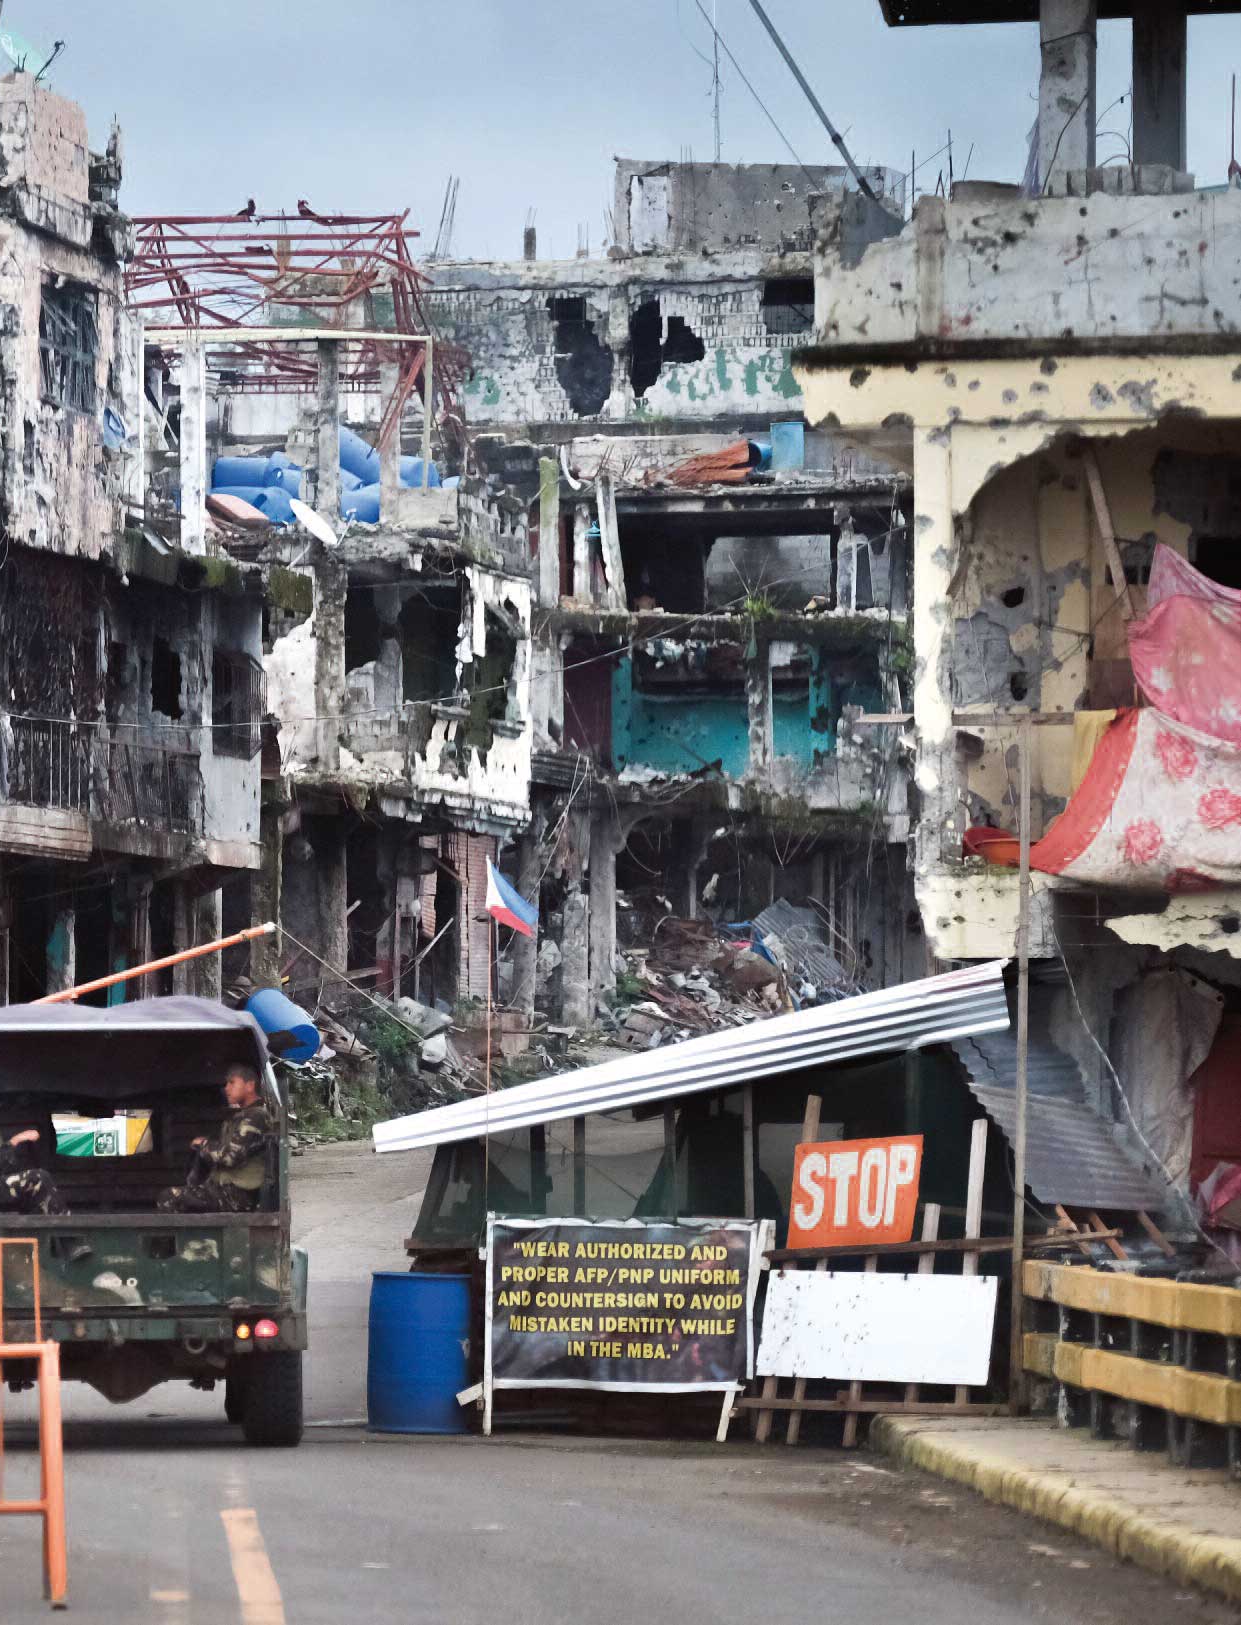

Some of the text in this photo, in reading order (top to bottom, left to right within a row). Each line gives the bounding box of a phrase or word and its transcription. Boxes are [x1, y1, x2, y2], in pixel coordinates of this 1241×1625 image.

[794, 1145, 917, 1230] STOP
[514, 1241, 728, 1261] "WEAR AUTHORIZED AND
[501, 1266, 740, 1287] PROPER AFP/PNP UNIFORM
[498, 1291, 743, 1310] AND COUNTERSIGN TO AVOID
[509, 1315, 736, 1335] MISTAKEN IDENTITY WHILE
[567, 1341, 679, 1359] IN THE MBA."
